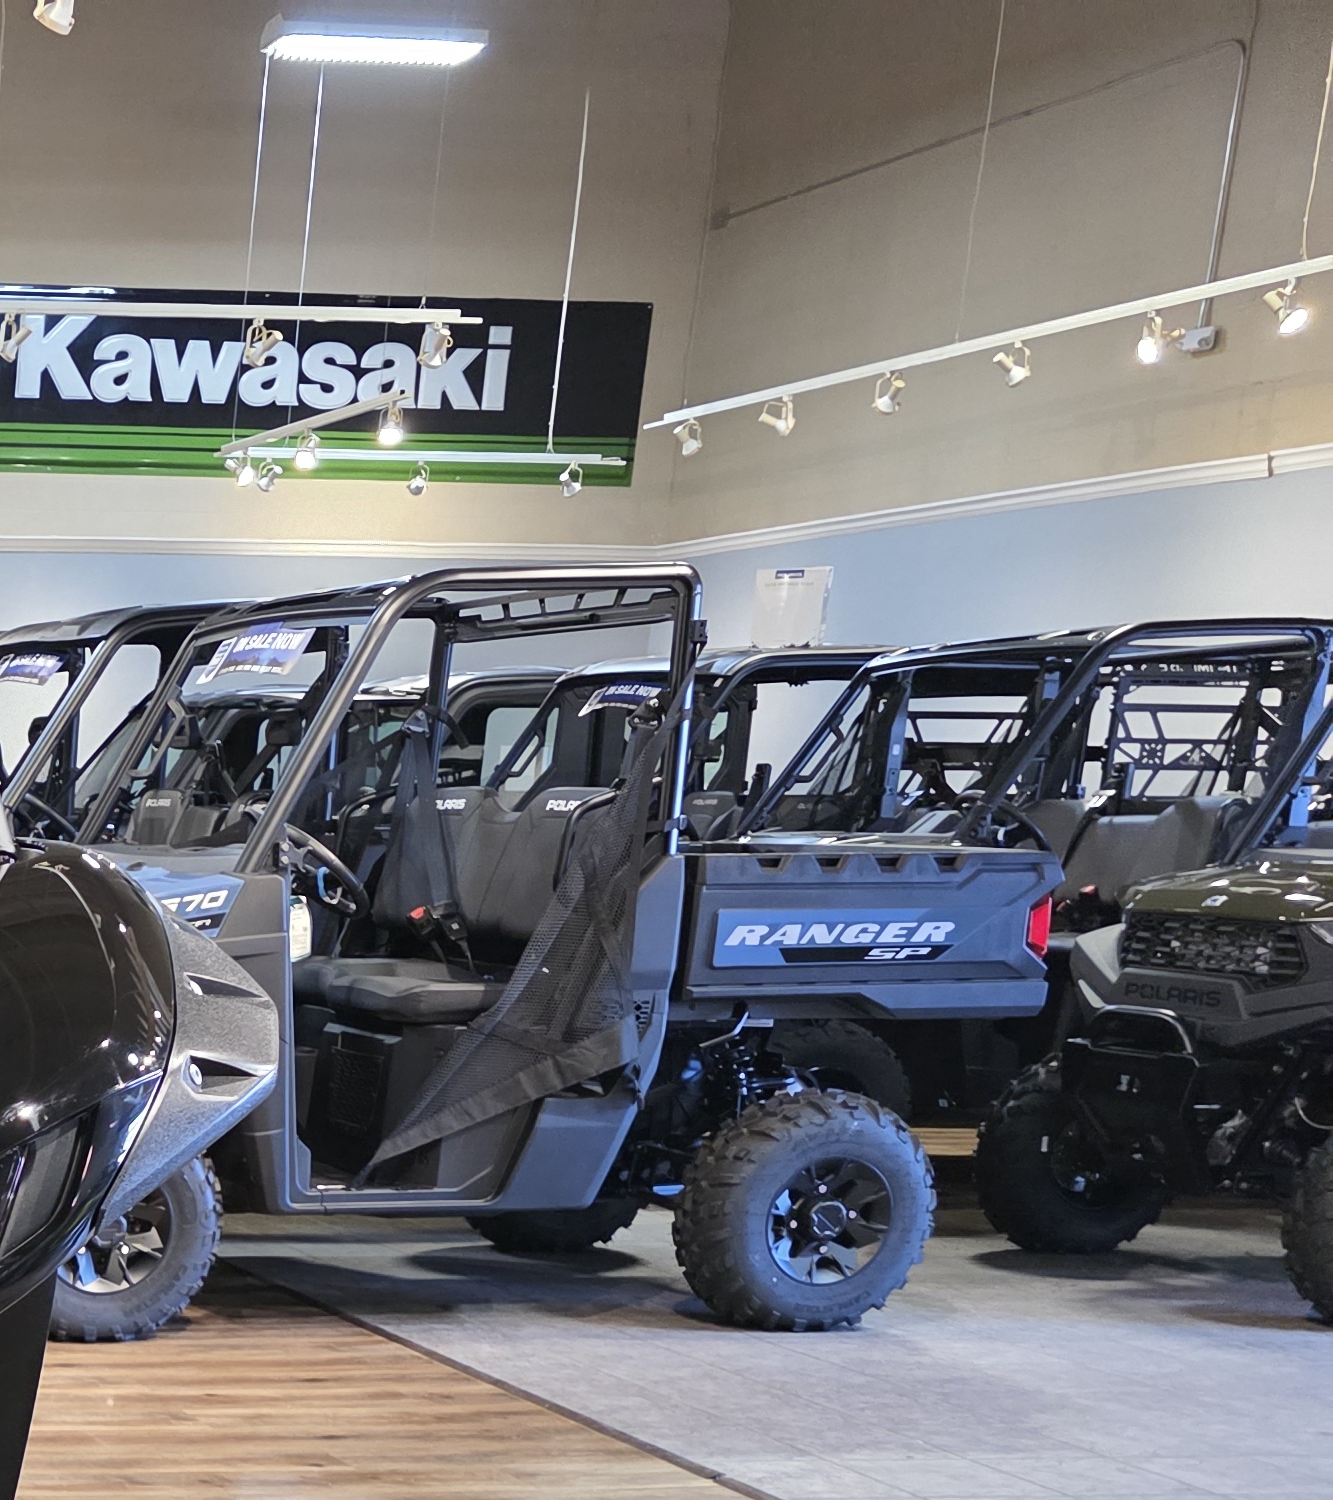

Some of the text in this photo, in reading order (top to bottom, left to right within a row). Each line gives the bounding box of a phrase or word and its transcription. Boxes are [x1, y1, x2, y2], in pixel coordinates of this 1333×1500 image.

[14, 314, 513, 411] Kawasaki
[271, 632, 307, 650] NOW
[545, 799, 583, 812] POLA
[723, 921, 957, 947] RANGER
[863, 947, 933, 960] SP
[1124, 982, 1222, 1008] POLARIS
